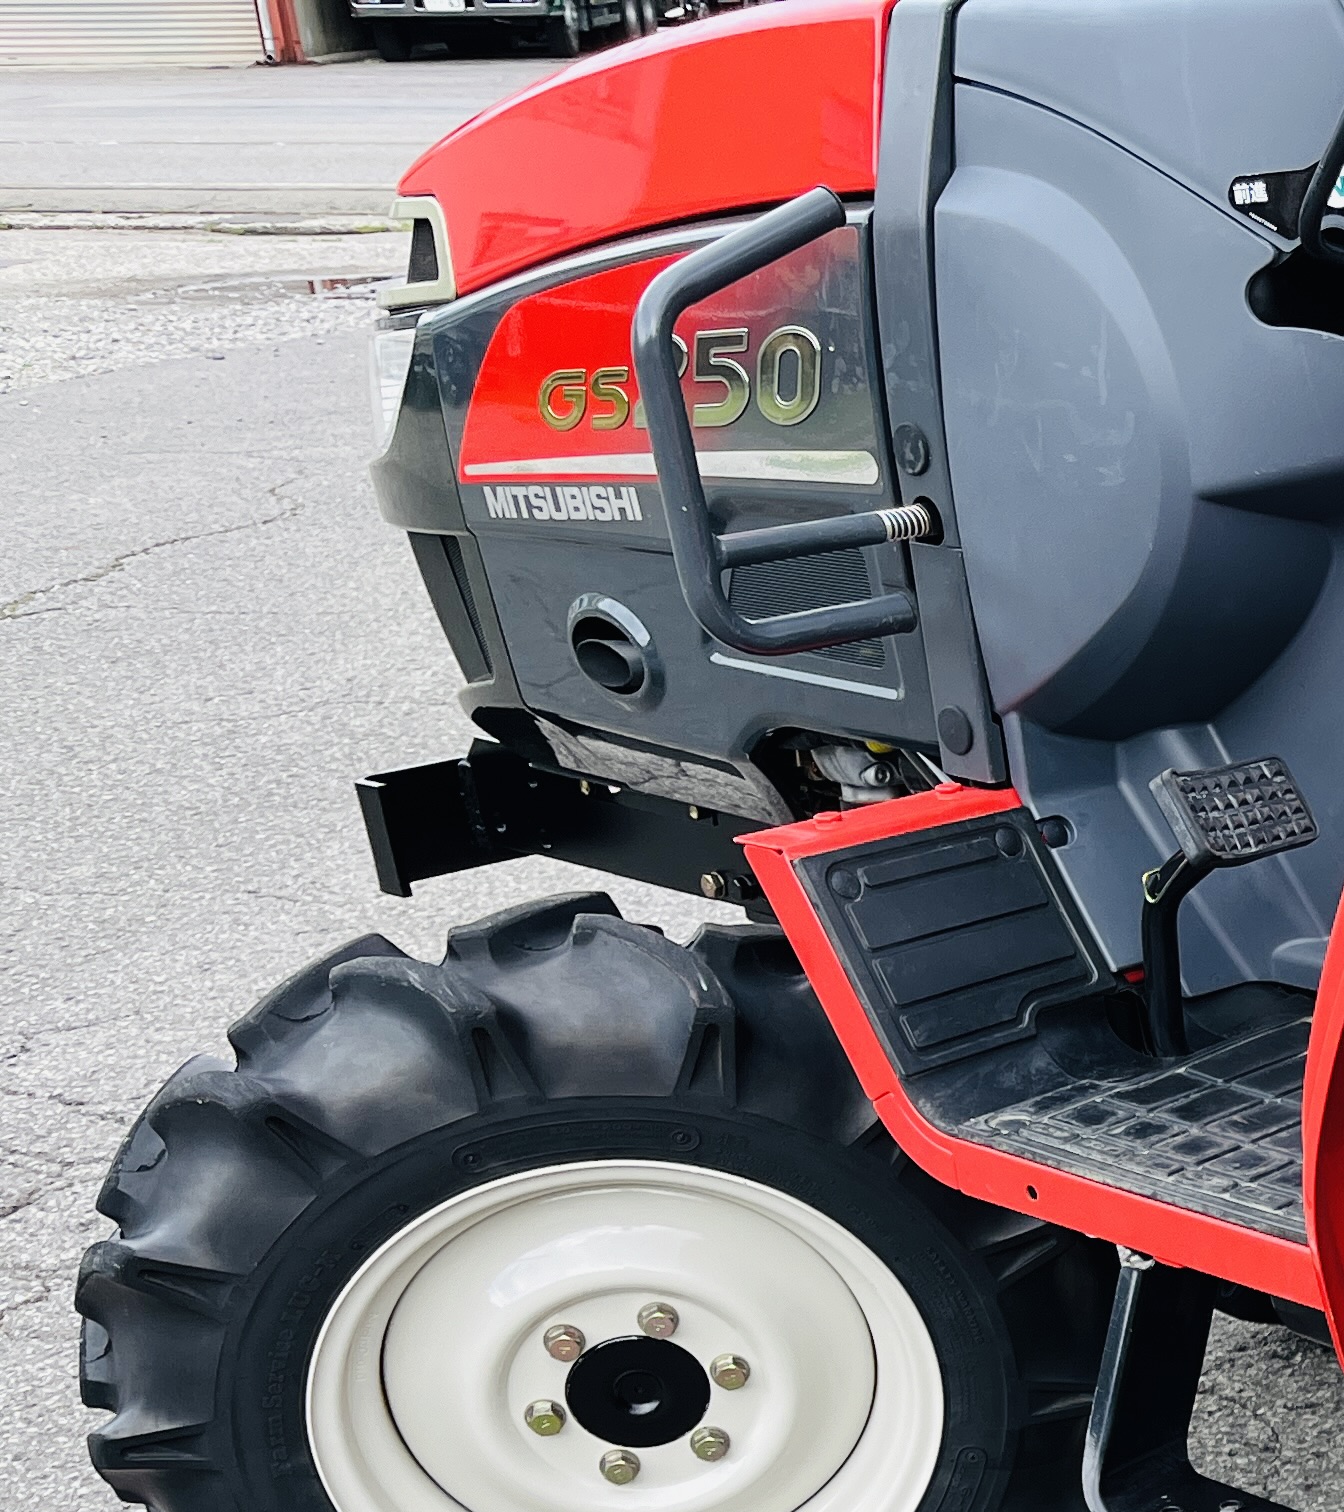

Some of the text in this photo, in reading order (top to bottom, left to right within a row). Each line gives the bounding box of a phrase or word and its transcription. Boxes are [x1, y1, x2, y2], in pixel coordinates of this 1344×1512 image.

[1233, 181, 1269, 205] 前進
[538, 325, 822, 432] GS50
[483, 486, 643, 522] MITSUBISHI
